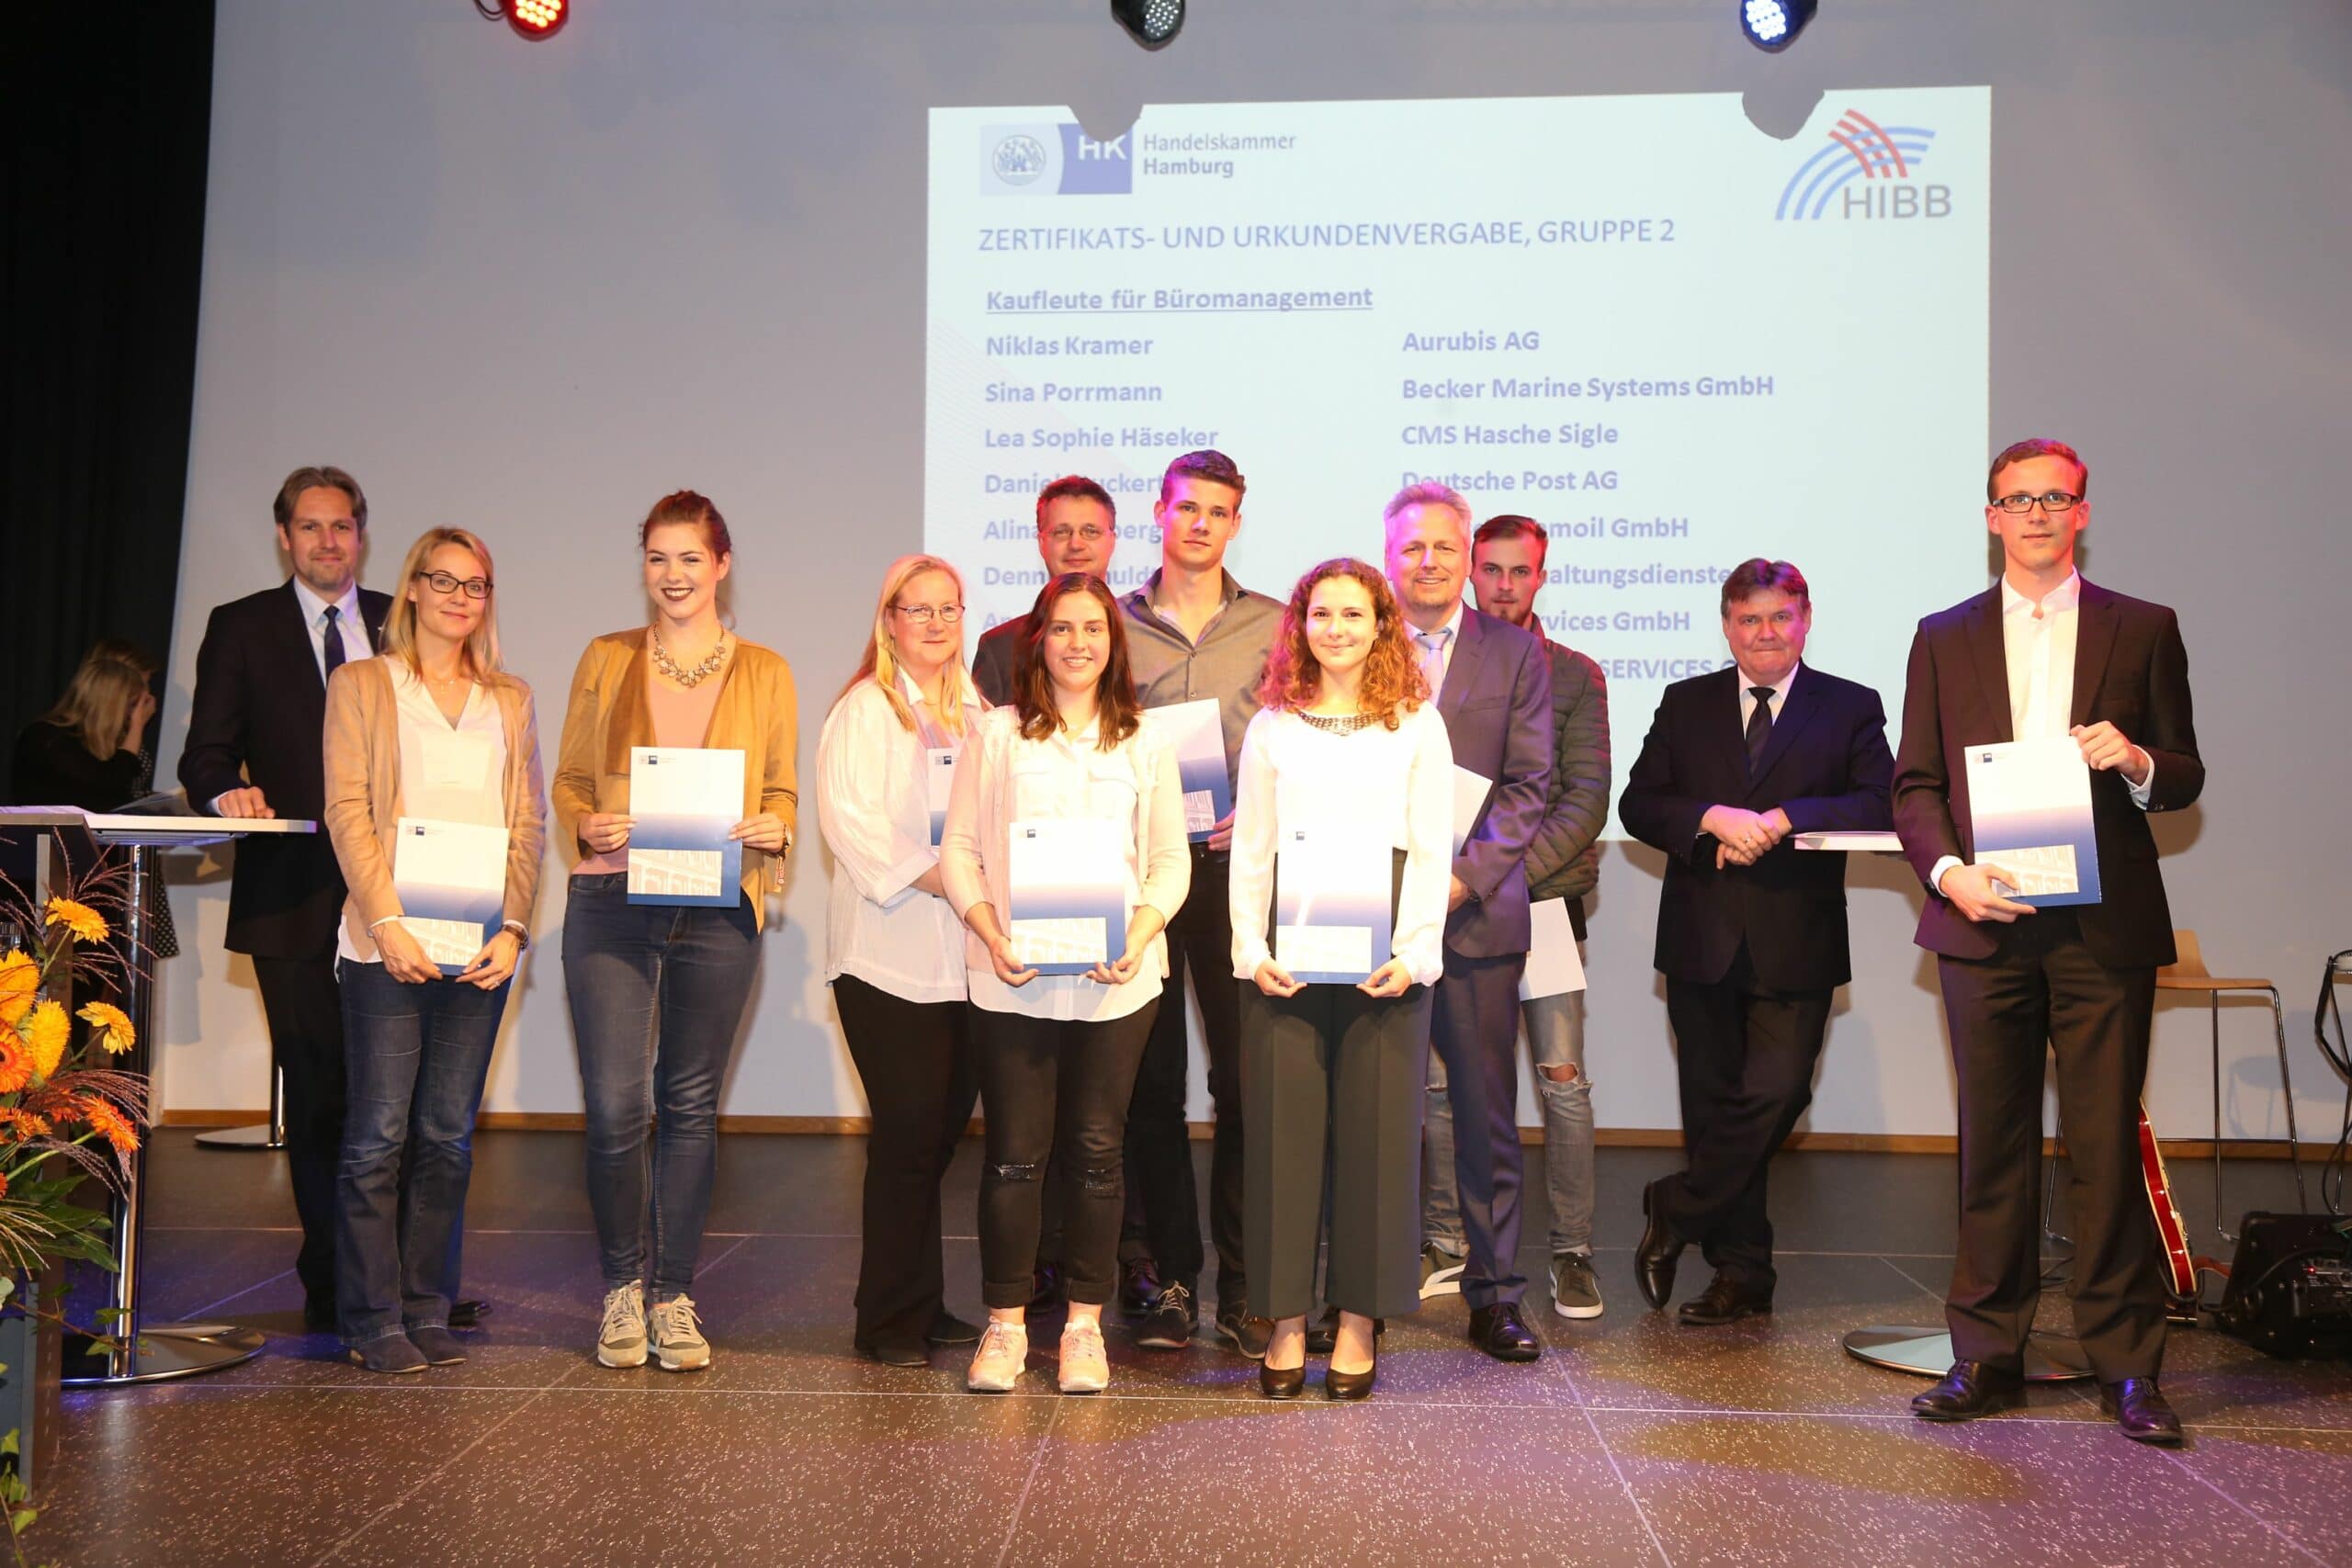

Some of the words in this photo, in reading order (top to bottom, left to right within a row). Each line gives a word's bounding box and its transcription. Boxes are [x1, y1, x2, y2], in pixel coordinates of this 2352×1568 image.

[1143, 132, 1296, 152] Handelskammer
[1143, 157, 1235, 178] Hamburg
[1842, 184, 1952, 220] HIBB
[978, 227, 1156, 251] ZERTIFIKATS-
[1162, 226, 1225, 249] UND
[1234, 221, 1532, 248] URKUNDENVERGABE,
[1538, 220, 1652, 243] GRUPPE
[1659, 219, 1675, 242] 2
[986, 290, 1103, 310] Kaufleute
[1110, 289, 1147, 309] für
[1154, 288, 1374, 310] Büromanagement
[986, 335, 1060, 356] Niklas
[1065, 335, 1154, 355] Kramer
[1402, 330, 1498, 353] Aurubis
[1503, 330, 1540, 352] AG
[985, 382, 1035, 402] Sina
[1044, 383, 1162, 402] Porrmann
[1402, 378, 1486, 399] Becker
[1491, 377, 1582, 399] Marine
[1587, 378, 1691, 402] Systems
[1696, 375, 1774, 398] GmbH
[985, 428, 1025, 448] Lea
[1032, 426, 1114, 452] Sophie
[1121, 427, 1219, 448] Häseker
[1401, 425, 1458, 446] CMS
[1464, 423, 1552, 446] Hasche
[1558, 423, 1619, 448] Sigle
[1521, 470, 1577, 491] Post
[1582, 469, 1619, 491] AG
[1611, 516, 1690, 538] GmbH
[984, 567, 1046, 586] Denn
[1612, 610, 1690, 631] GmbH
